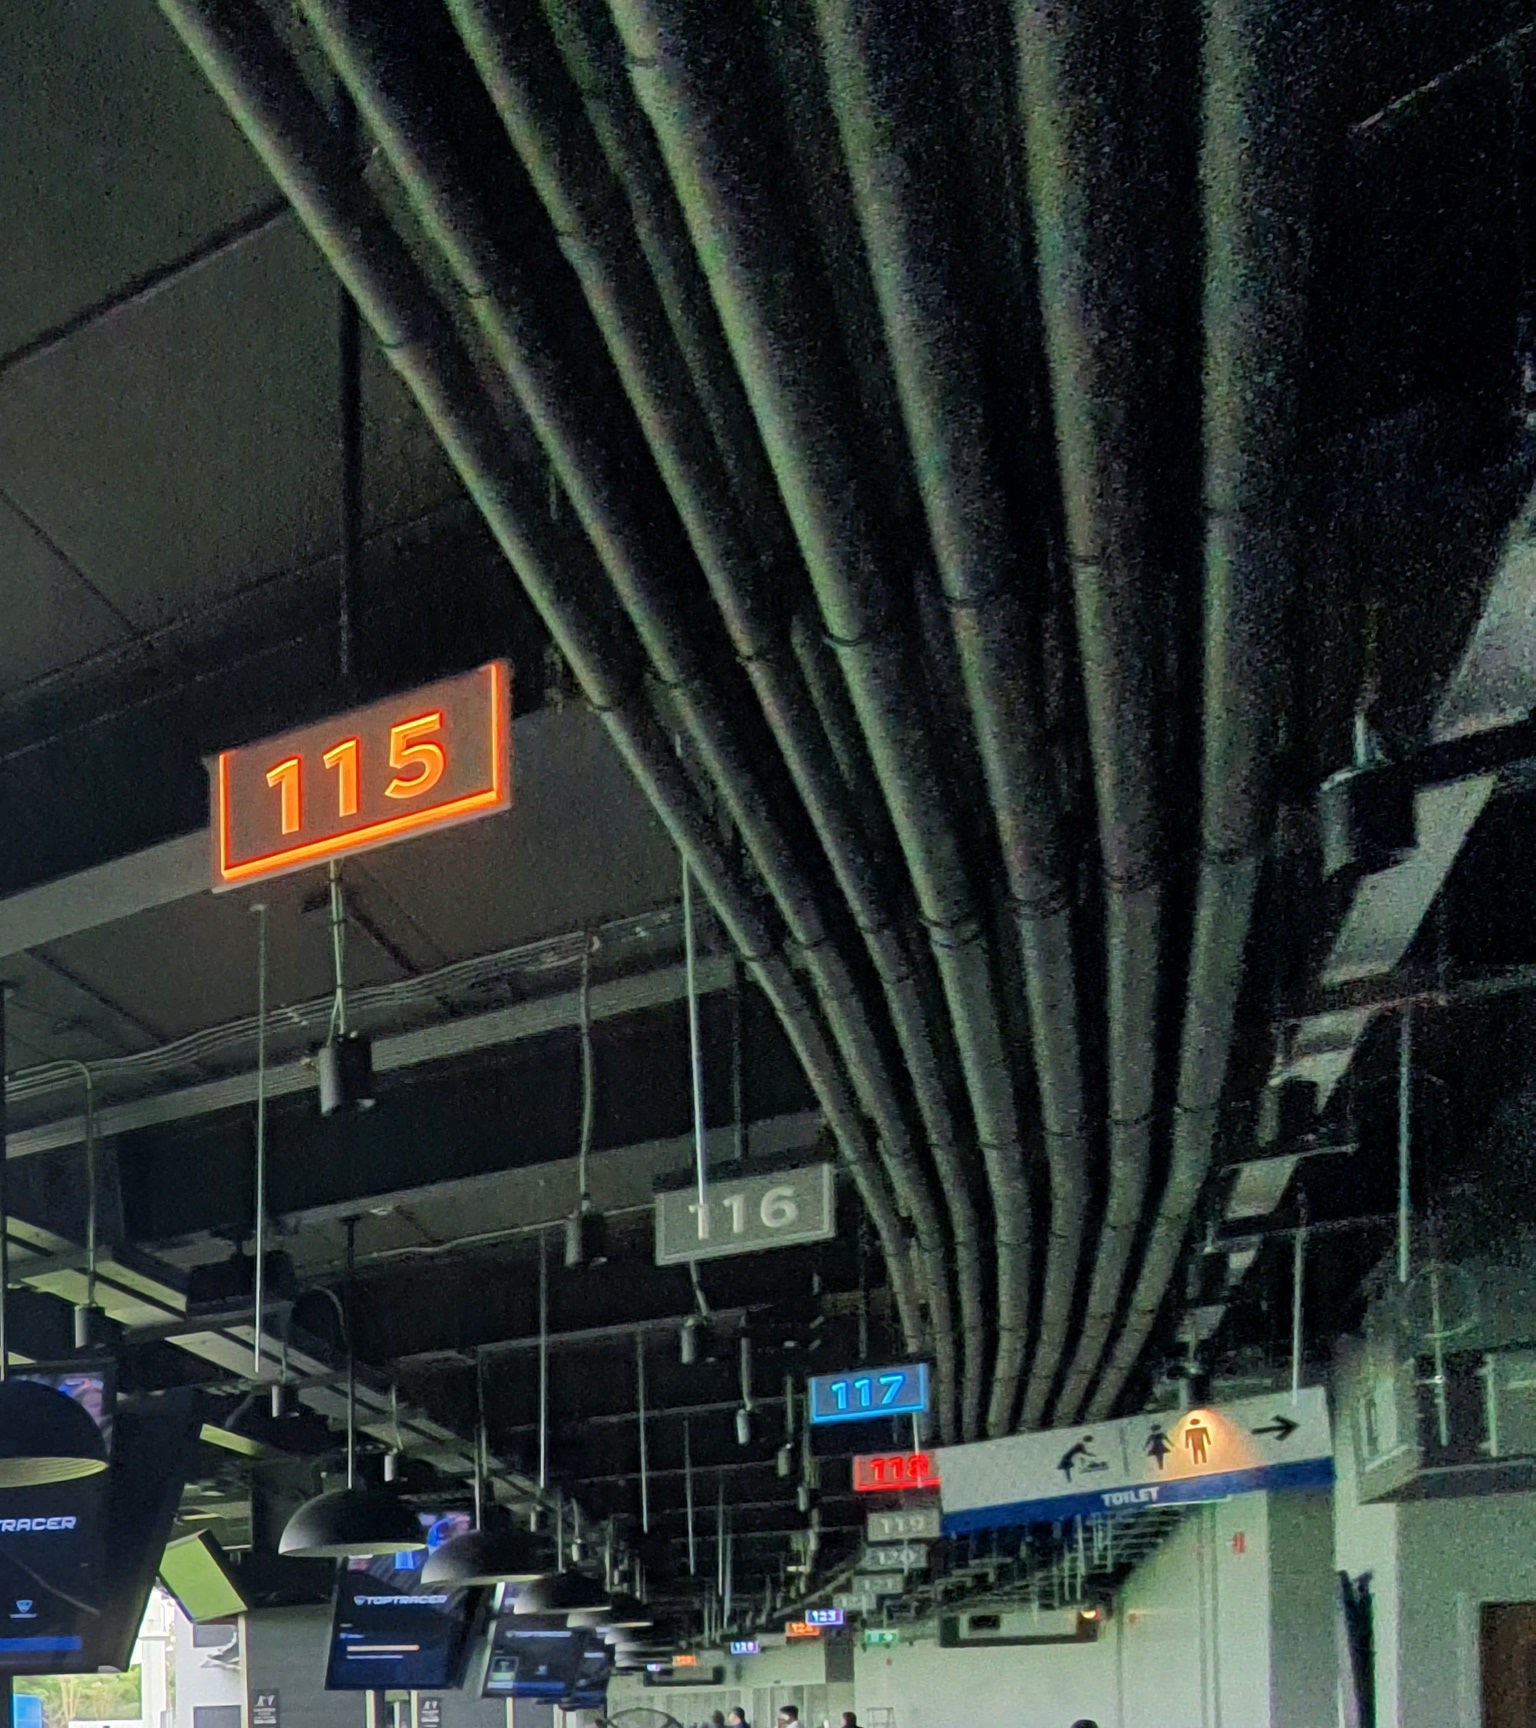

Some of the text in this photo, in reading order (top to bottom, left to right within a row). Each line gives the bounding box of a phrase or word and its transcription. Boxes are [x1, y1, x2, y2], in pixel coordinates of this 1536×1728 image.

[265, 710, 446, 836] 115
[687, 1185, 799, 1241] 116
[830, 1373, 905, 1410] 117
[869, 1453, 929, 1482] 118
[1100, 1486, 1160, 1507] TOILET
